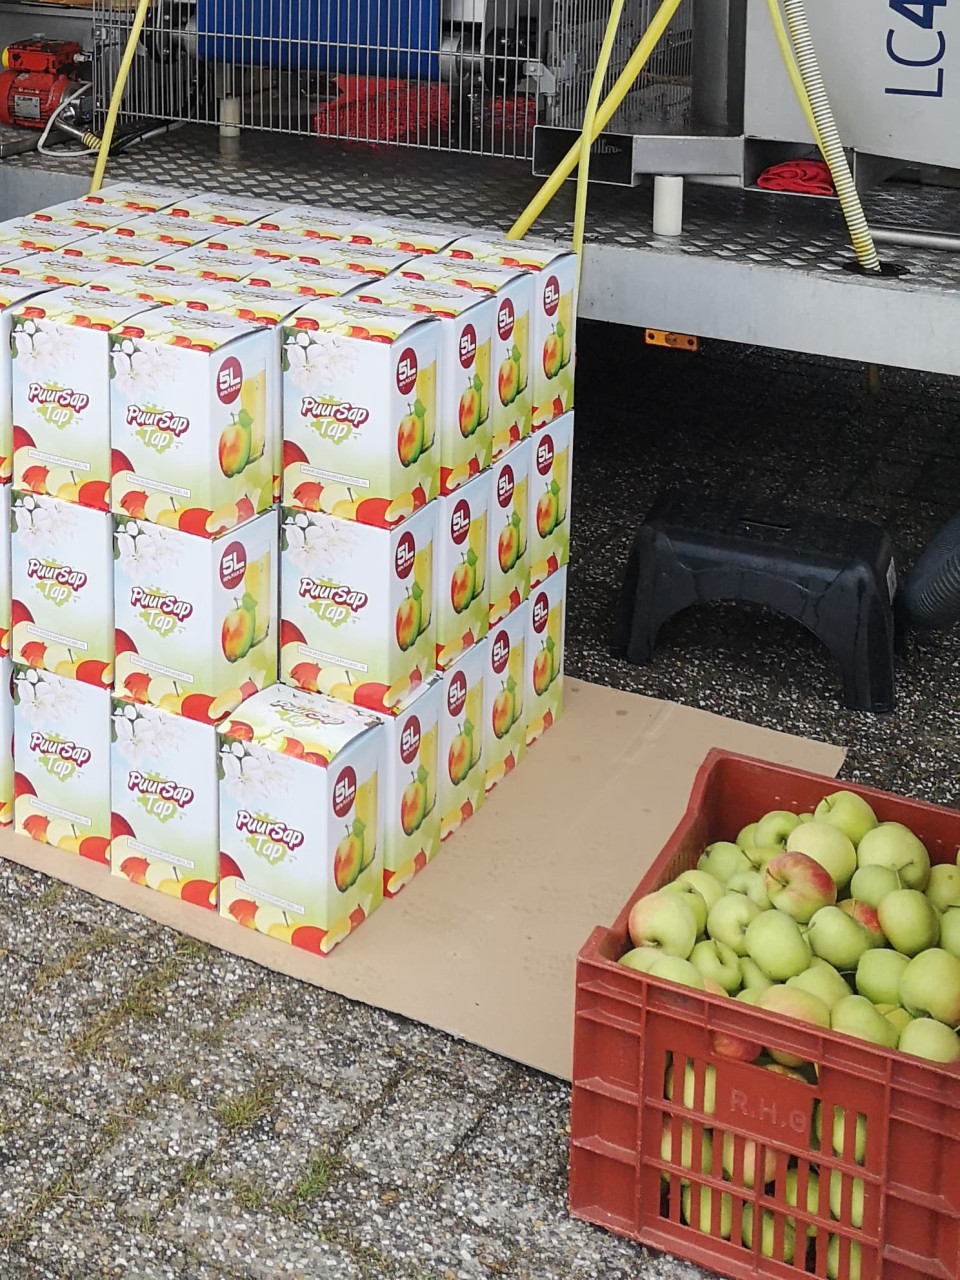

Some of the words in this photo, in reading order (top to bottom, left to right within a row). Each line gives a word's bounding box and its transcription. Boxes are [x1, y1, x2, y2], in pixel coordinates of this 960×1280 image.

[544, 285, 558, 304] 5L
[498, 308, 514, 329] 5L
[461, 334, 476, 356] 5L
[220, 366, 241, 390] 5L
[398, 358, 416, 381] 5L
[28, 383, 90, 414] PuurSap
[45, 404, 70, 426] Tap
[127, 405, 190, 438] PuurSap
[301, 397, 370, 429] PuurSap
[143, 427, 169, 449] Tap
[319, 420, 347, 441] Tap
[538, 444, 553, 464] 5L
[498, 474, 513, 496] 5L
[453, 509, 469, 531] 5L
[222, 552, 245, 576] 5L
[396, 542, 414, 566] 5L
[28, 559, 87, 592] PuurSap
[44, 580, 68, 602] Tap
[299, 578, 368, 613] PuurSap
[131, 587, 193, 623] PuurSap
[317, 600, 346, 622] Tap
[534, 602, 548, 622] 5L
[147, 609, 173, 631] Tap
[493, 640, 509, 661] 5L
[449, 681, 466, 704] 5L
[30, 732, 91, 768] PuurSap
[402, 726, 419, 751] 5L
[46, 754, 70, 776] Tap
[128, 771, 194, 809] PuurSap
[335, 777, 355, 804] 5L
[145, 794, 172, 817] Tap
[236, 810, 304, 852] PuurSap
[255, 834, 283, 860] Tap
